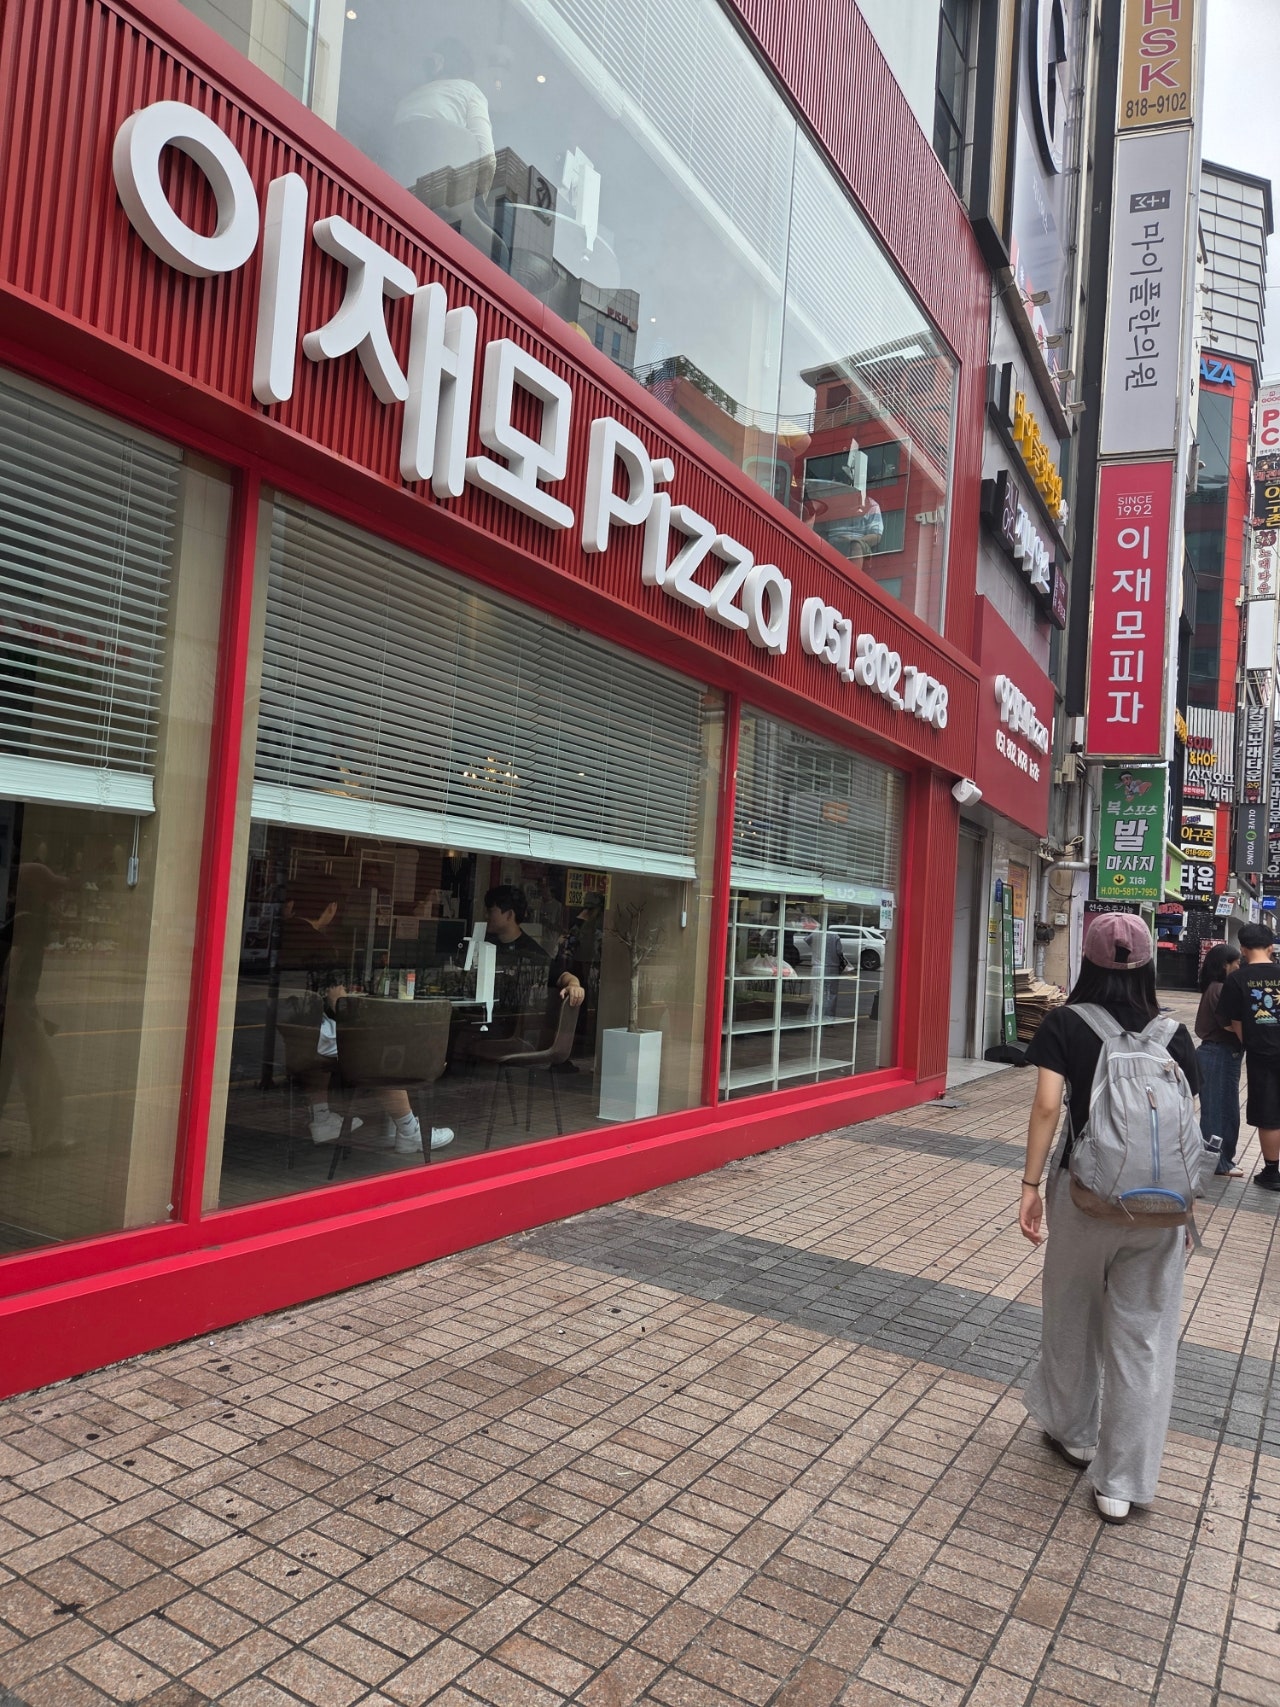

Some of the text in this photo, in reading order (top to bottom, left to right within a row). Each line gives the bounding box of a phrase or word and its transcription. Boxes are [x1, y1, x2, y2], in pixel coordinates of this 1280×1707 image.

[1138, 0, 1181, 93] HSK
[1125, 92, 1187, 119] 818-9102
[1125, 221, 1164, 391] 마이플한의원
[113, 100, 574, 530] 이재모
[582, 416, 792, 655] Pizza
[1118, 495, 1152, 506] SINCE
[1118, 504, 1152, 516] 1992
[1106, 526, 1151, 724] 이재모피자
[1186, 735, 1213, 751] SOJU
[1122, 804, 1158, 816] 스포츠
[1247, 809, 1256, 829] OLIVE
[1114, 819, 1149, 852] 발
[1106, 855, 1155, 872] 마사지
[1246, 841, 1255, 865] YOUNG
[1129, 876, 1146, 885] 지하
